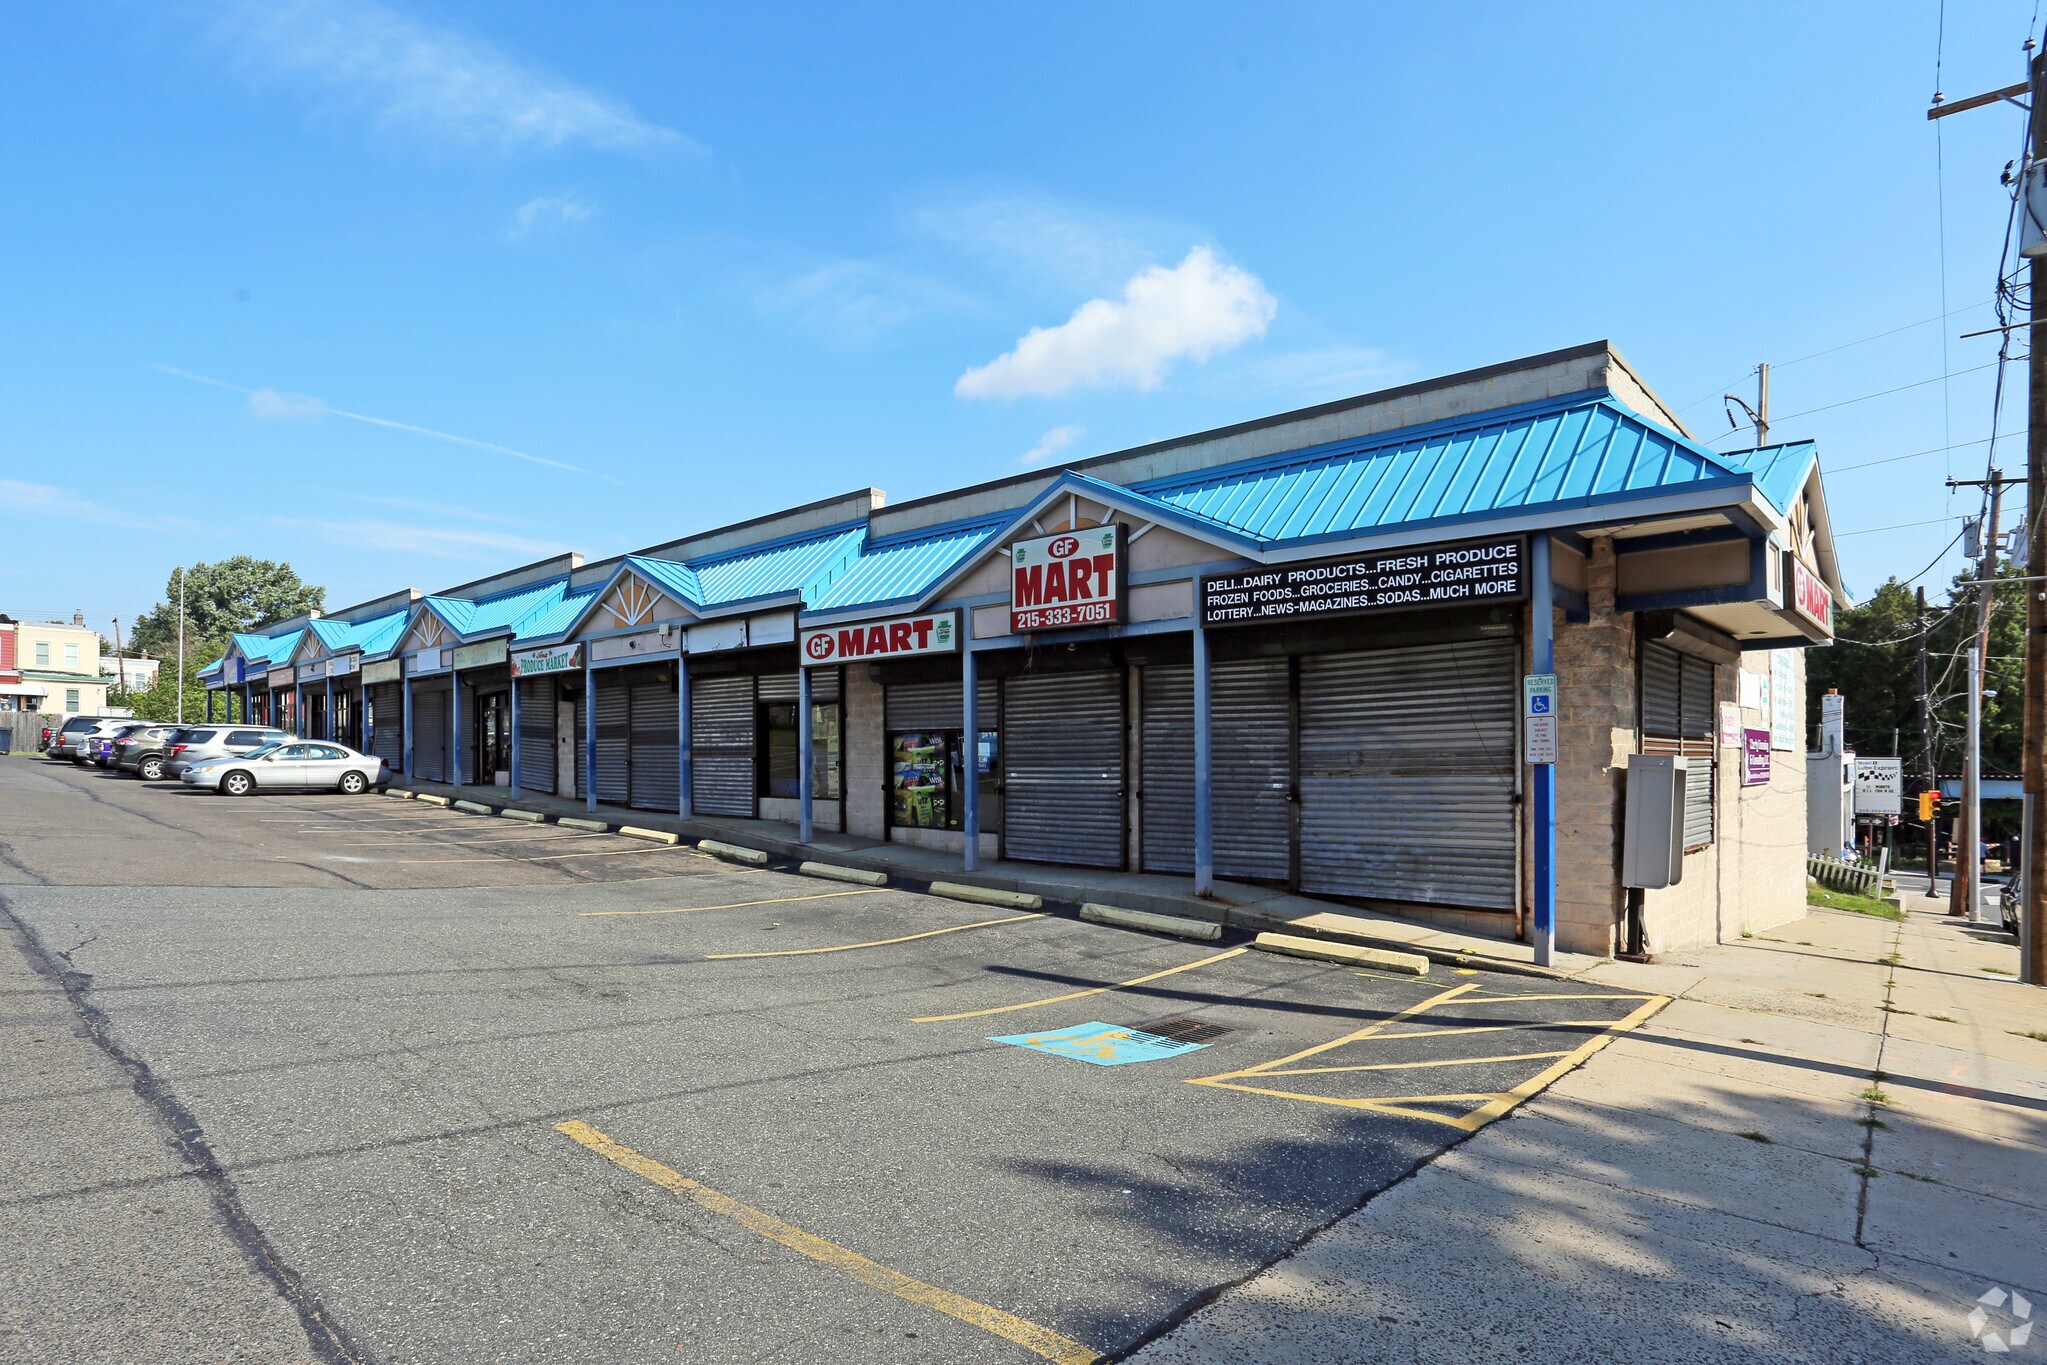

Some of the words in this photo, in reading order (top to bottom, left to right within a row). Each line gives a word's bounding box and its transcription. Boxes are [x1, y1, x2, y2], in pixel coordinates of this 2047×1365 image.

[1053, 539, 1074, 556] GF
[1435, 544, 1517, 566] PRODUCE
[1015, 553, 1114, 608] MART
[1474, 579, 1517, 595] MORE
[1207, 592, 1249, 607] FROZEN
[1806, 574, 1829, 627] MART
[1017, 603, 1110, 628] 215-333-7051
[811, 636, 830, 656] GF
[838, 618, 933, 658] MART
[521, 659, 545, 673] PRODUCE
[545, 652, 569, 670] MARKET
